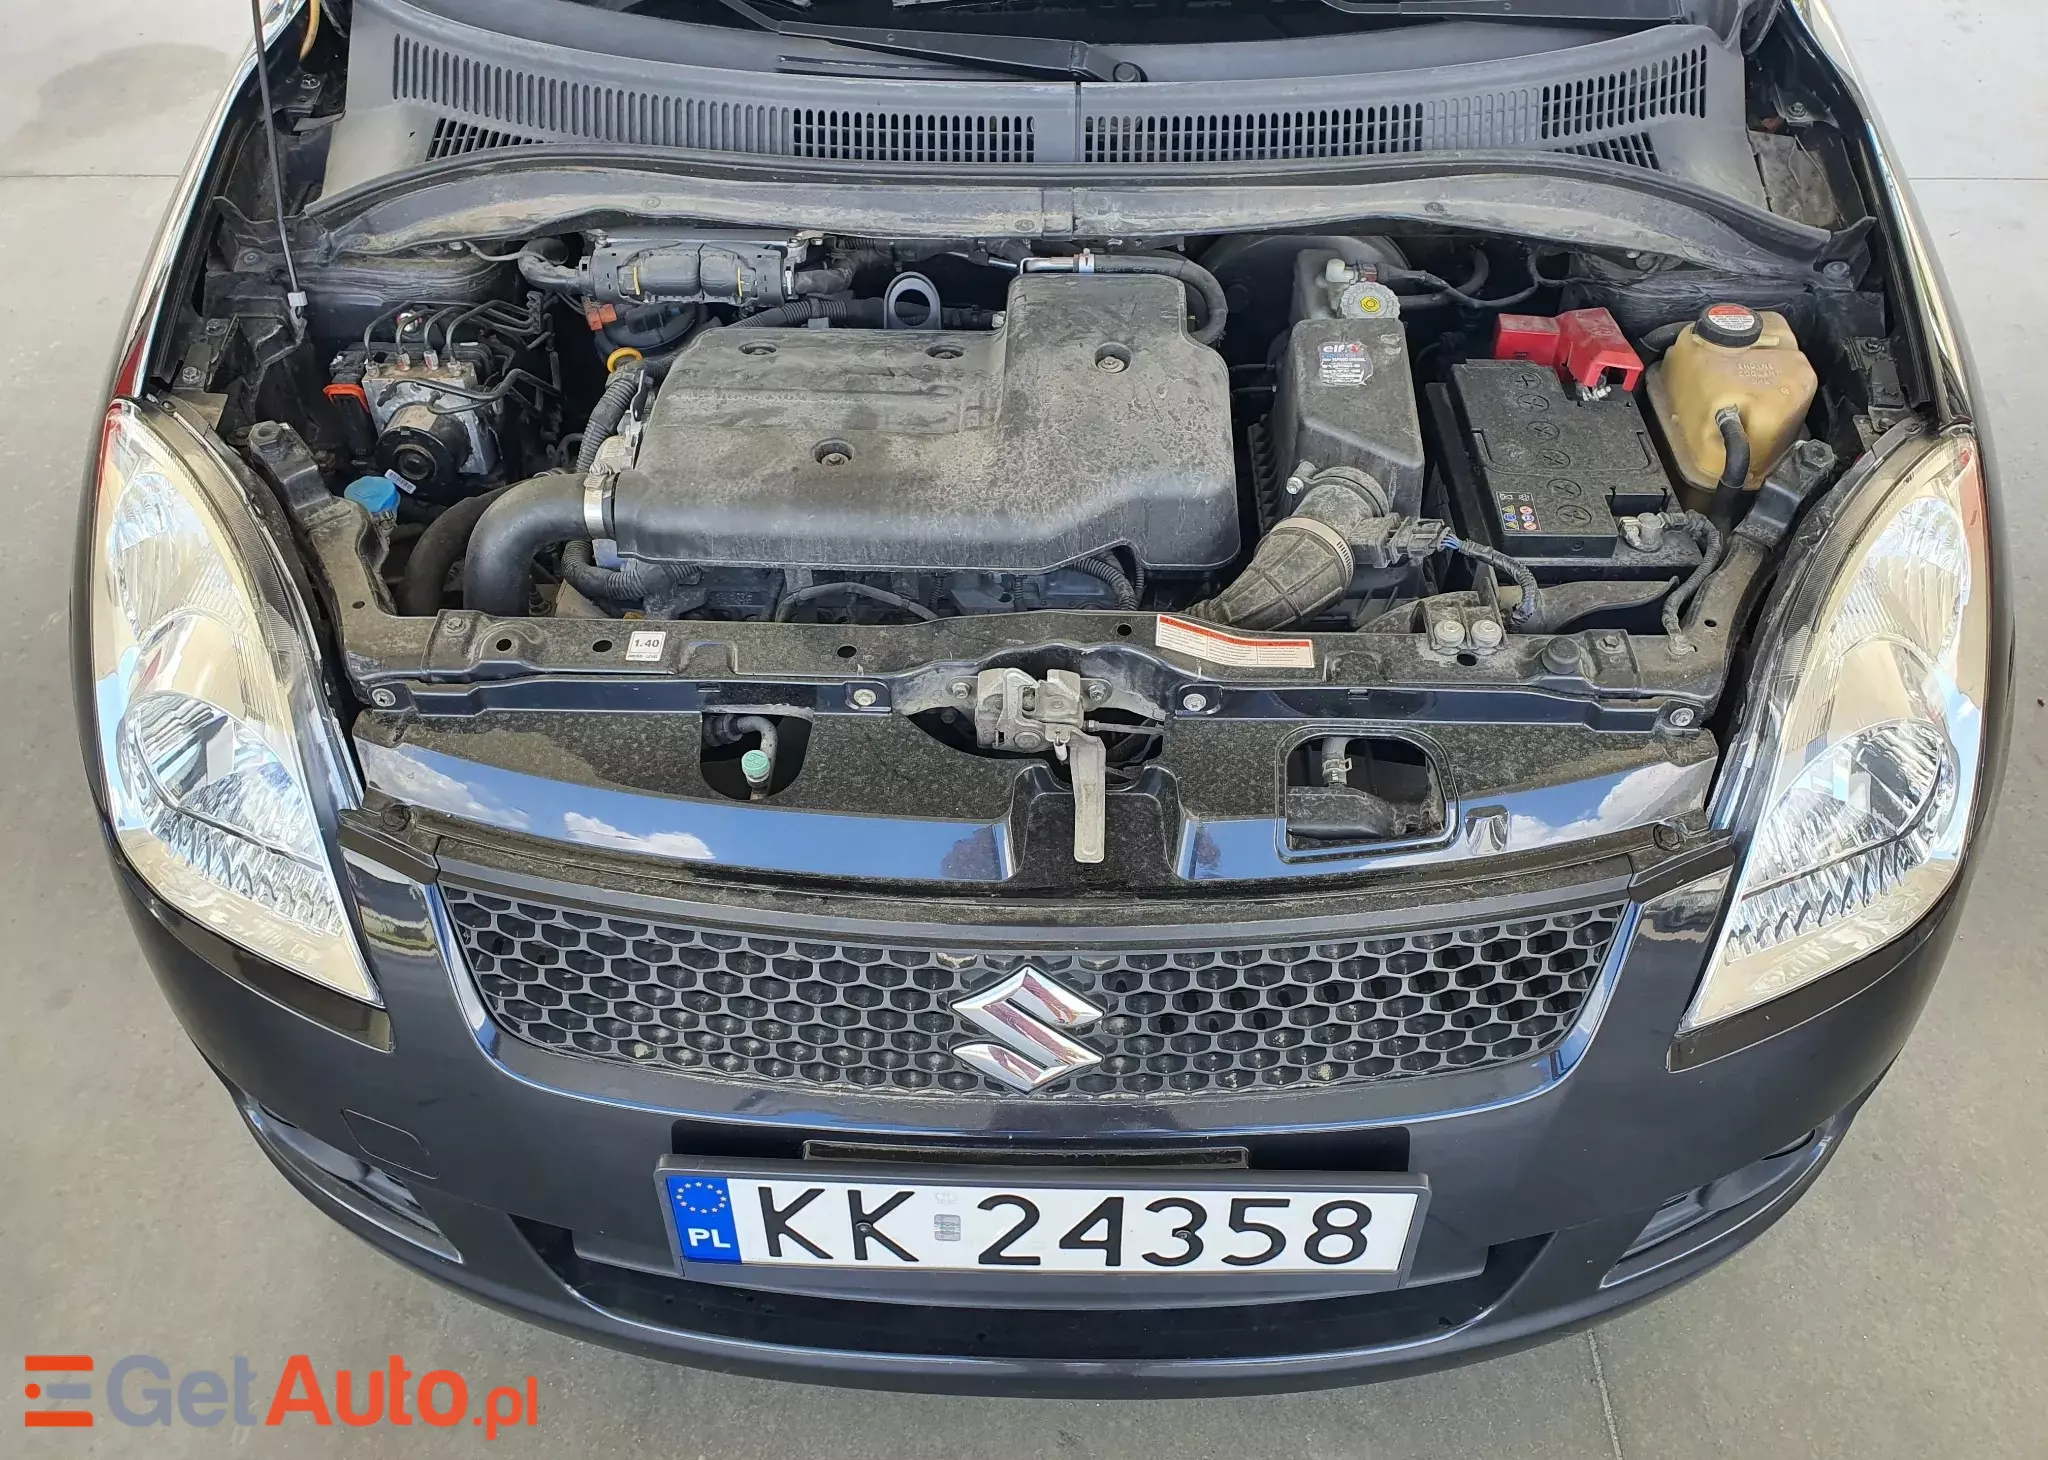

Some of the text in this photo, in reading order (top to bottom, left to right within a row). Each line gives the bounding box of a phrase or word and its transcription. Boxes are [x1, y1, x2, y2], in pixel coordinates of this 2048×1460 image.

[1322, 344, 1345, 353] elf
[634, 639, 660, 648] 1.40
[757, 1186, 1373, 1267] KK 24358
[688, 1227, 731, 1249] PL
